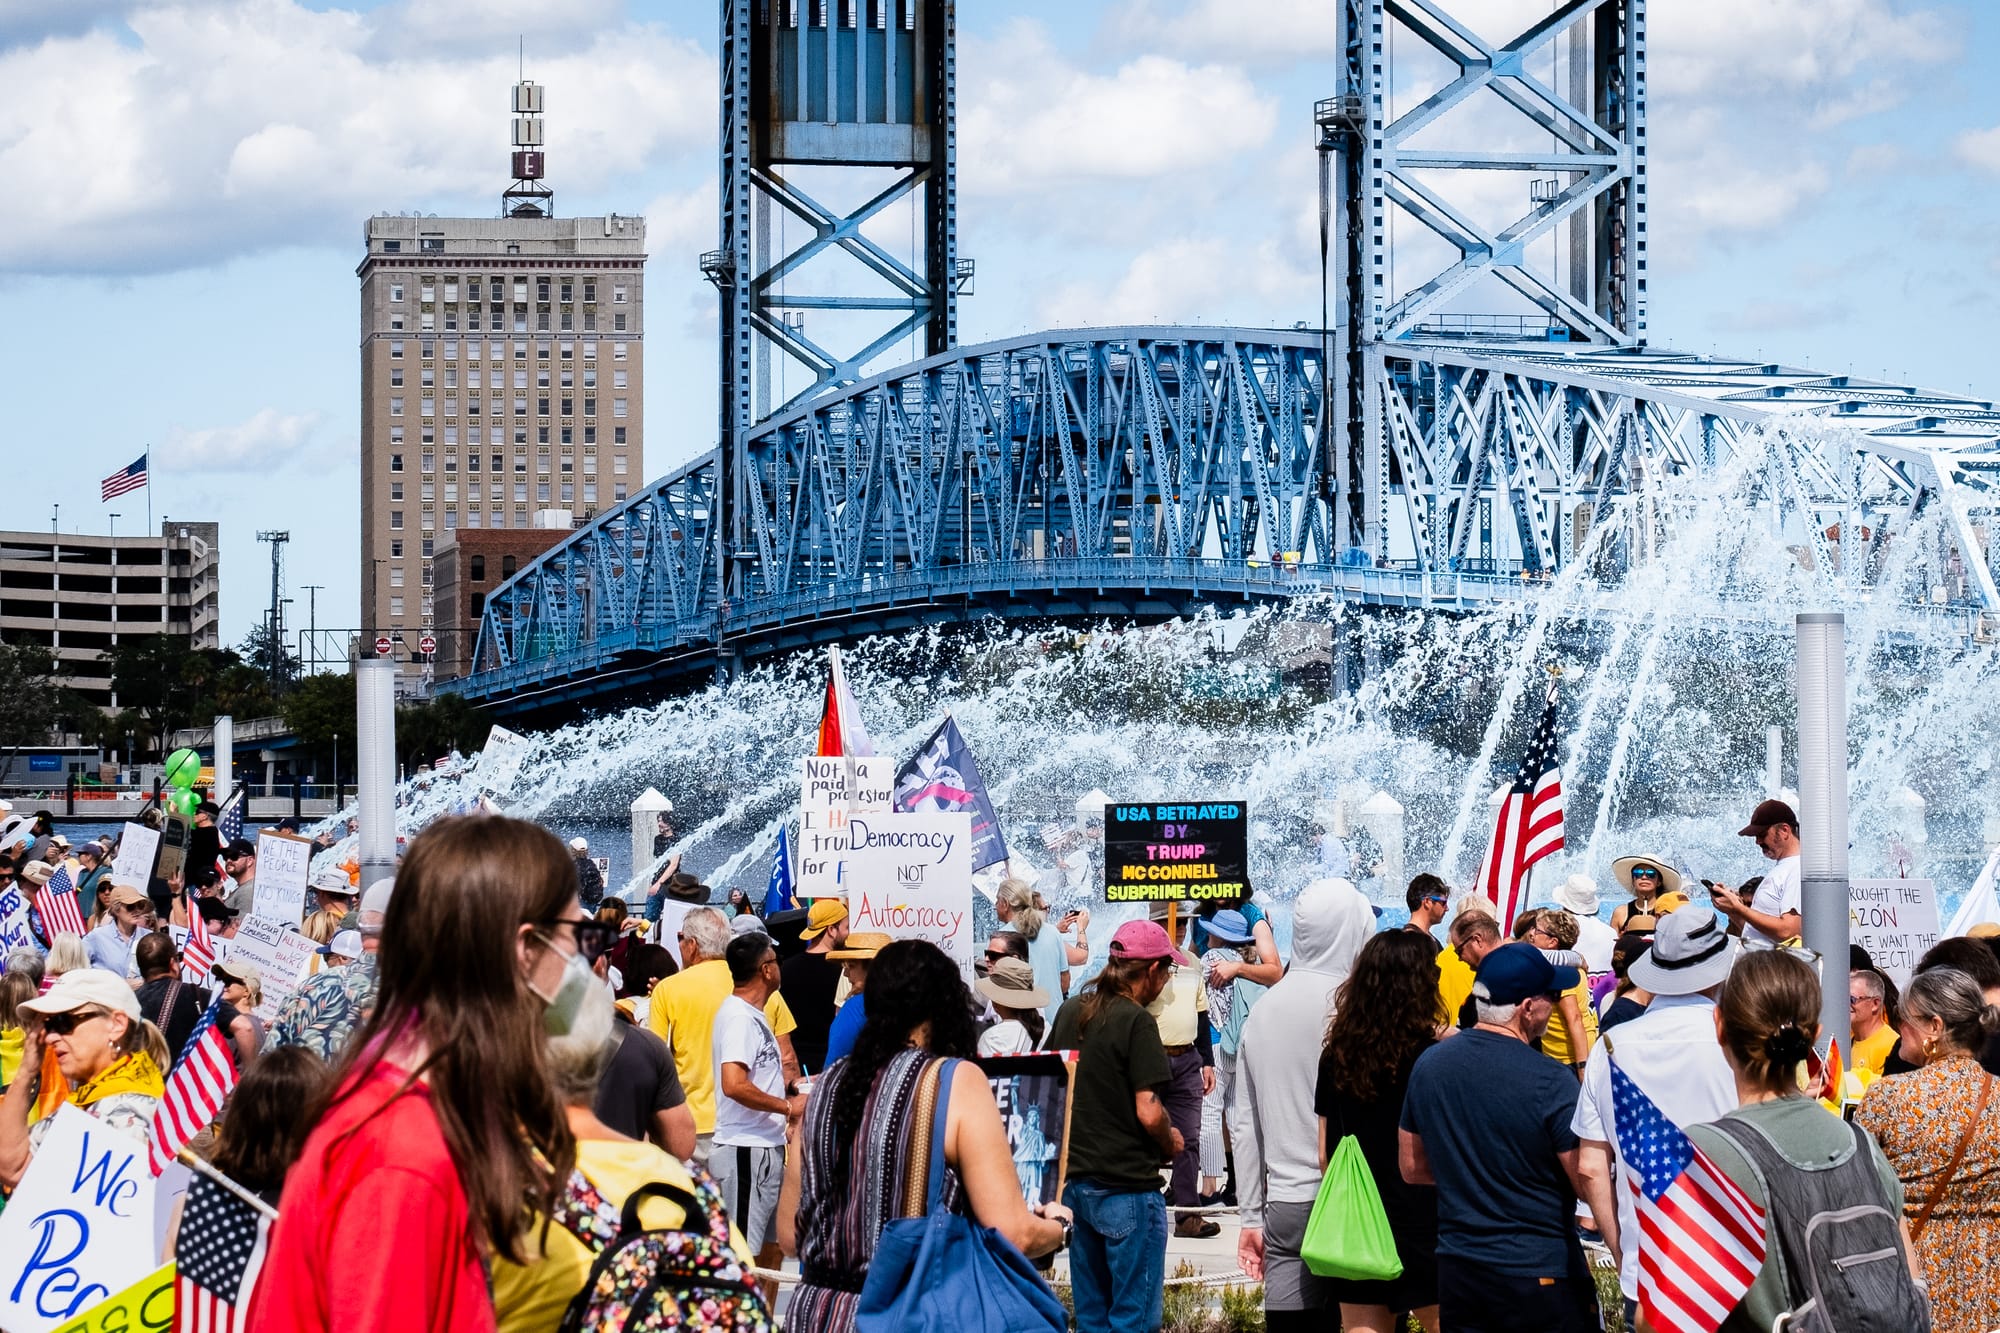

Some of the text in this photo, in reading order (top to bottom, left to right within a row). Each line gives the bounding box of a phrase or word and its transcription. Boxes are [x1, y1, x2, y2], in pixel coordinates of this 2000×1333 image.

[806, 760, 869, 779] Not a
[811, 774, 845, 799] paid
[829, 788, 893, 806] proestor,
[802, 811, 817, 830] I
[1116, 805, 1239, 822] USA BETRAYED
[1164, 824, 1188, 839] BY
[263, 839, 301, 860] WE THE
[811, 834, 848, 852] tru
[850, 819, 954, 864] Democracy
[1146, 844, 1206, 860] TRUMP
[263, 856, 298, 873] PEOPLE
[802, 858, 828, 876] for
[897, 863, 928, 883] NOT
[256, 884, 301, 904] NO KINGS
[1107, 883, 1243, 900] SUBPRIME COURT
[1894, 888, 1922, 904] THE
[853, 891, 963, 938] Autocracy
[248, 917, 279, 936] IN OUR
[1854, 935, 1873, 949] WE
[1880, 934, 1909, 949] WANT
[71, 1131, 138, 1217] We
